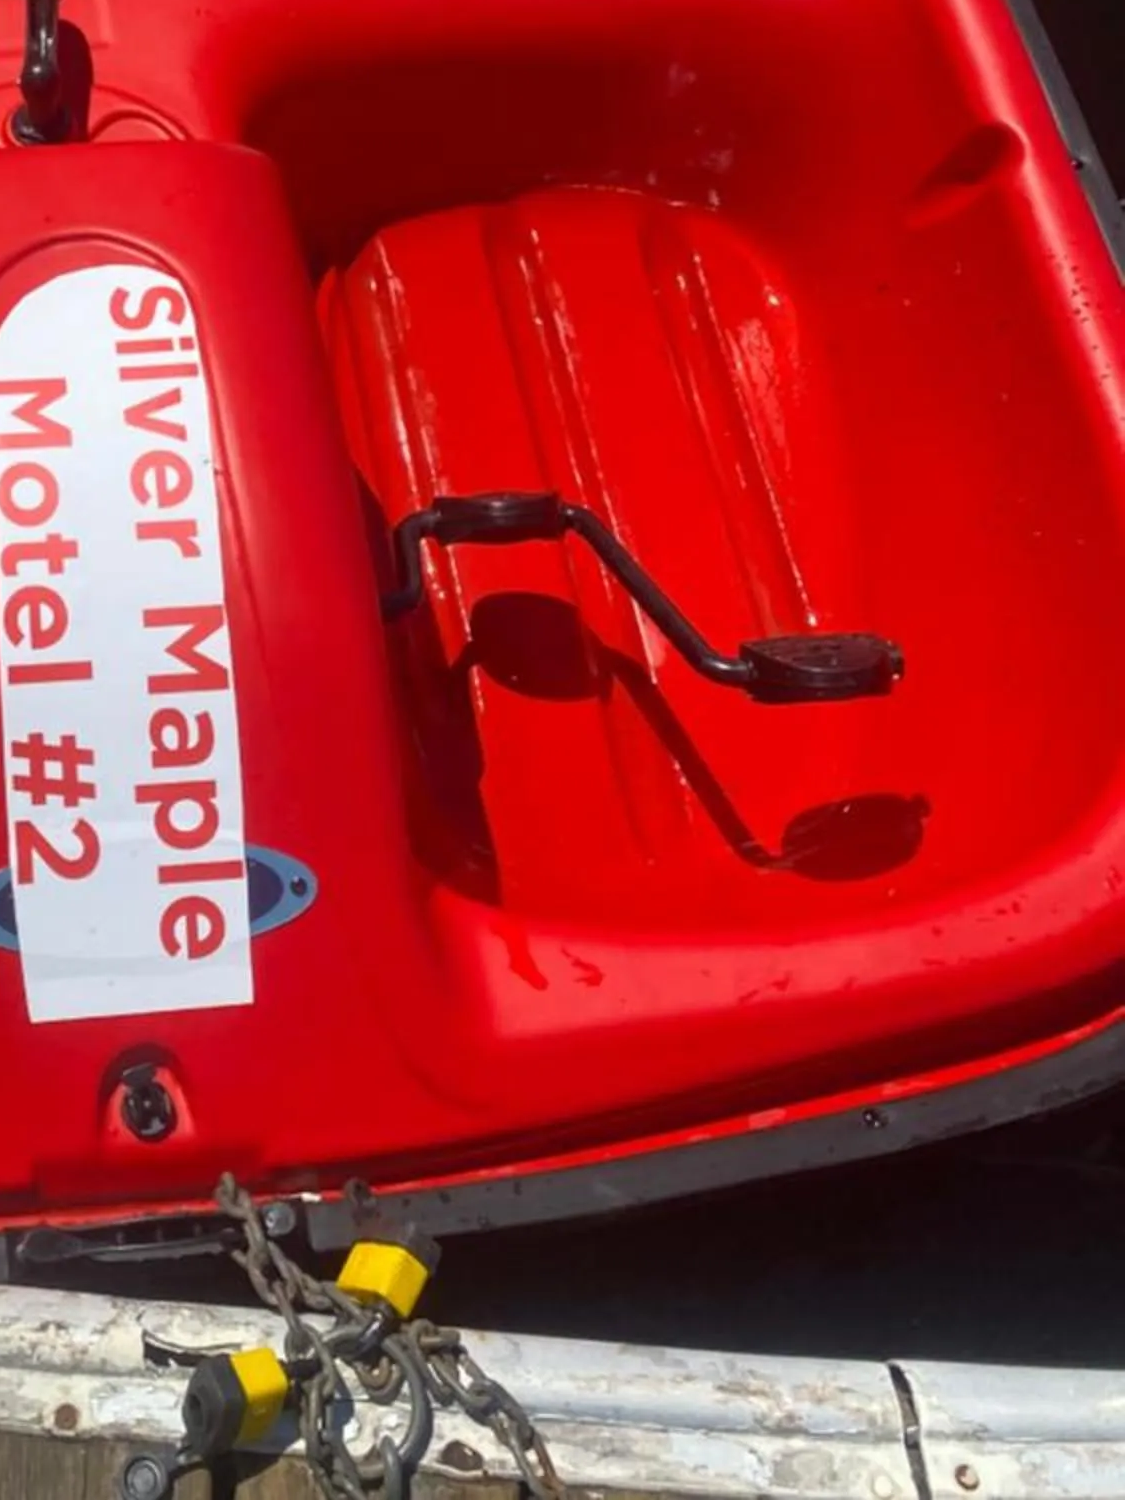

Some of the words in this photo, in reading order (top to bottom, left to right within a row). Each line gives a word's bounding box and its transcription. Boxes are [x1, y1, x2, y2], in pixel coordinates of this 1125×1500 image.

[109, 285, 202, 558] Silver
[10, 732, 100, 885] #2
[133, 604, 244, 960] Maple
